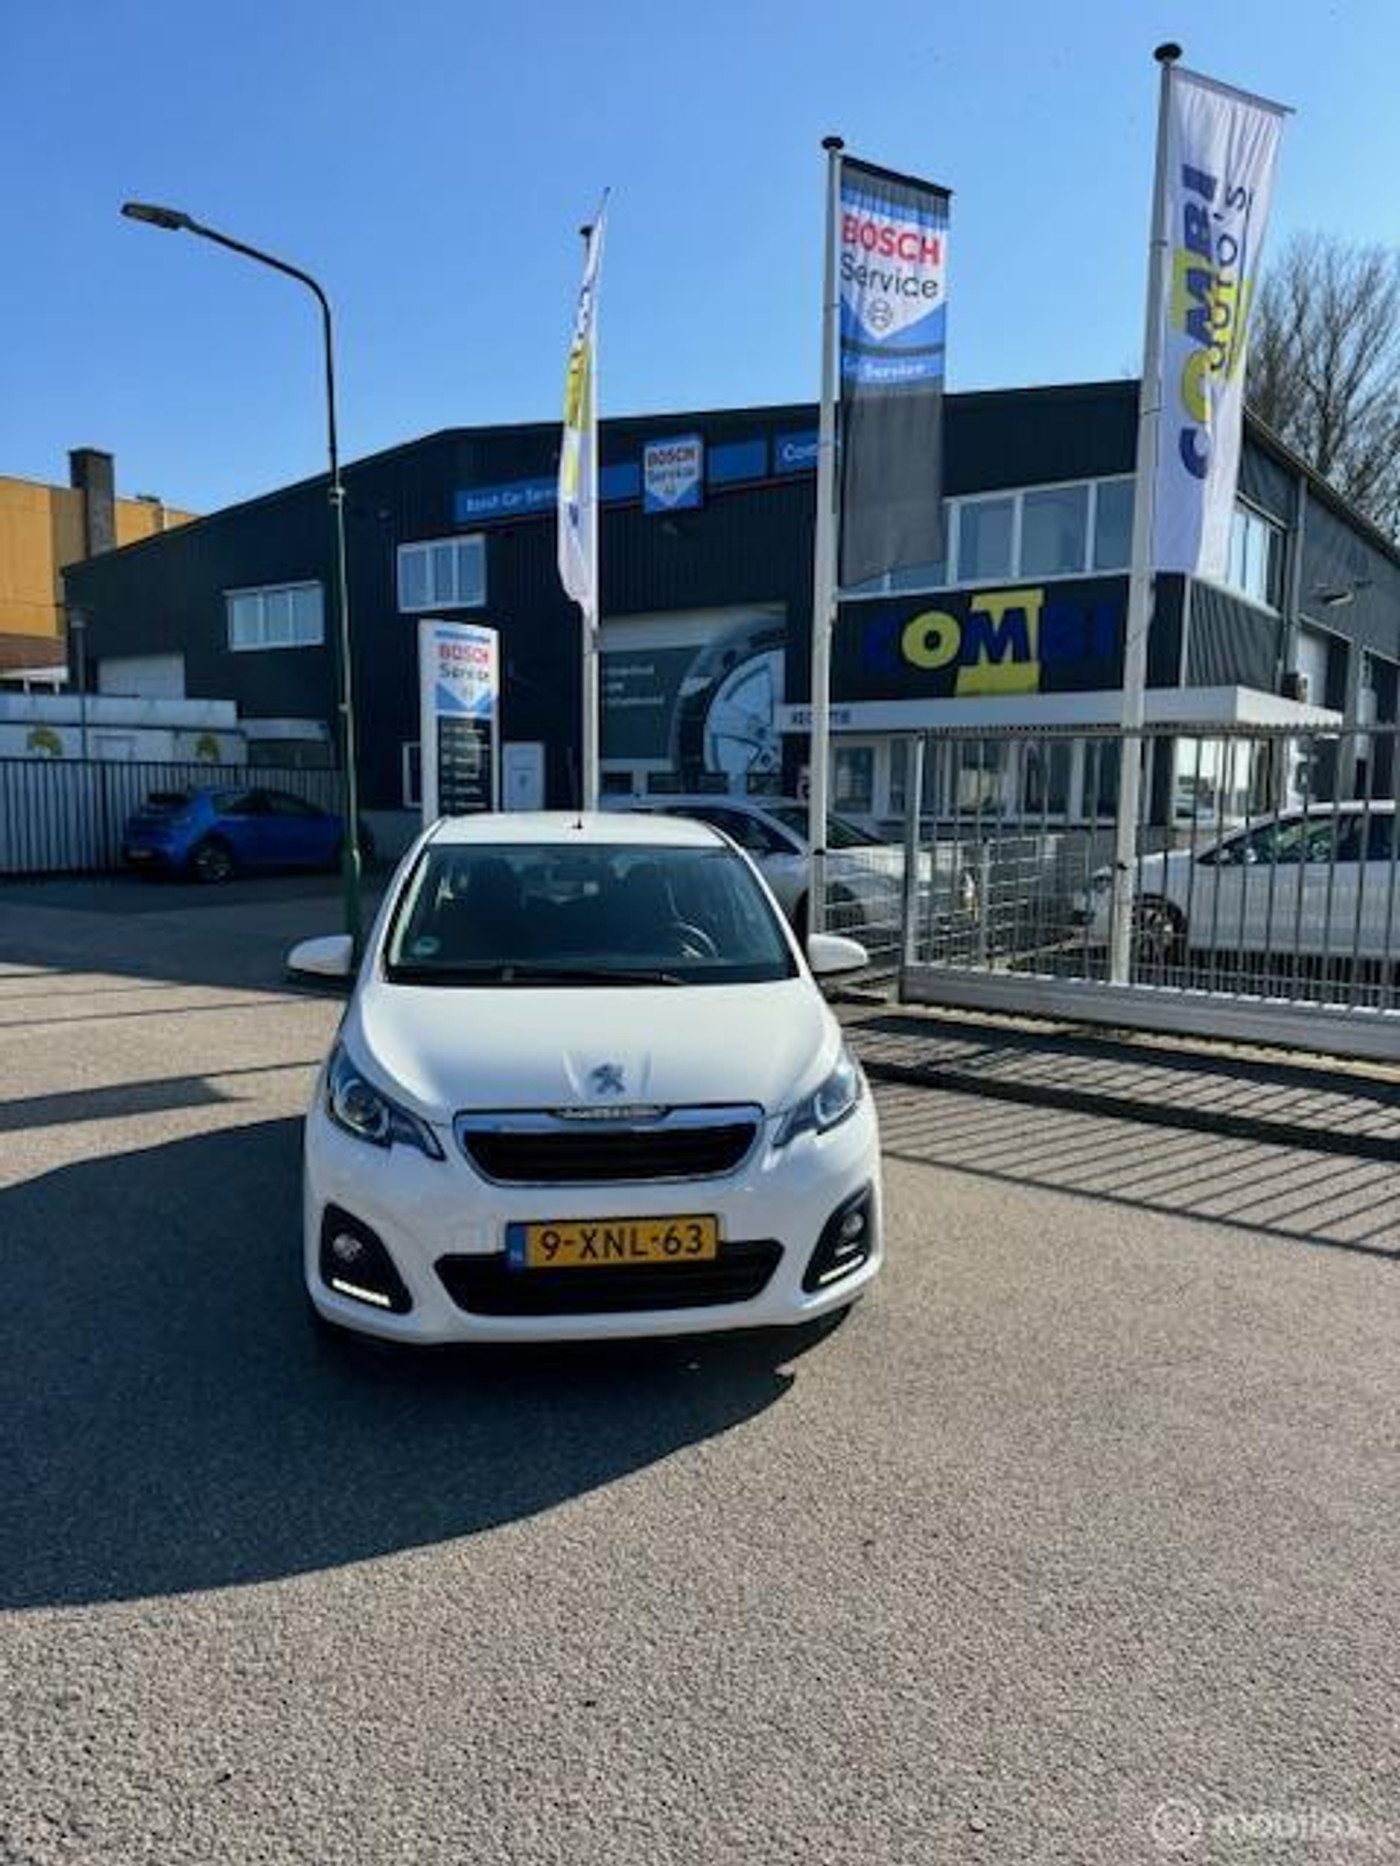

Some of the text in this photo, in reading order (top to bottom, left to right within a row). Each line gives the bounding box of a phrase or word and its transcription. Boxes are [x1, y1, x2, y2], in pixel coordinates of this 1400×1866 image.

[841, 214, 941, 267] BOSCH
[840, 251, 940, 299] Service
[647, 446, 696, 468] BOSCH
[438, 642, 489, 664] BOSCH
[539, 1224, 705, 1262] 9-XNL-63
